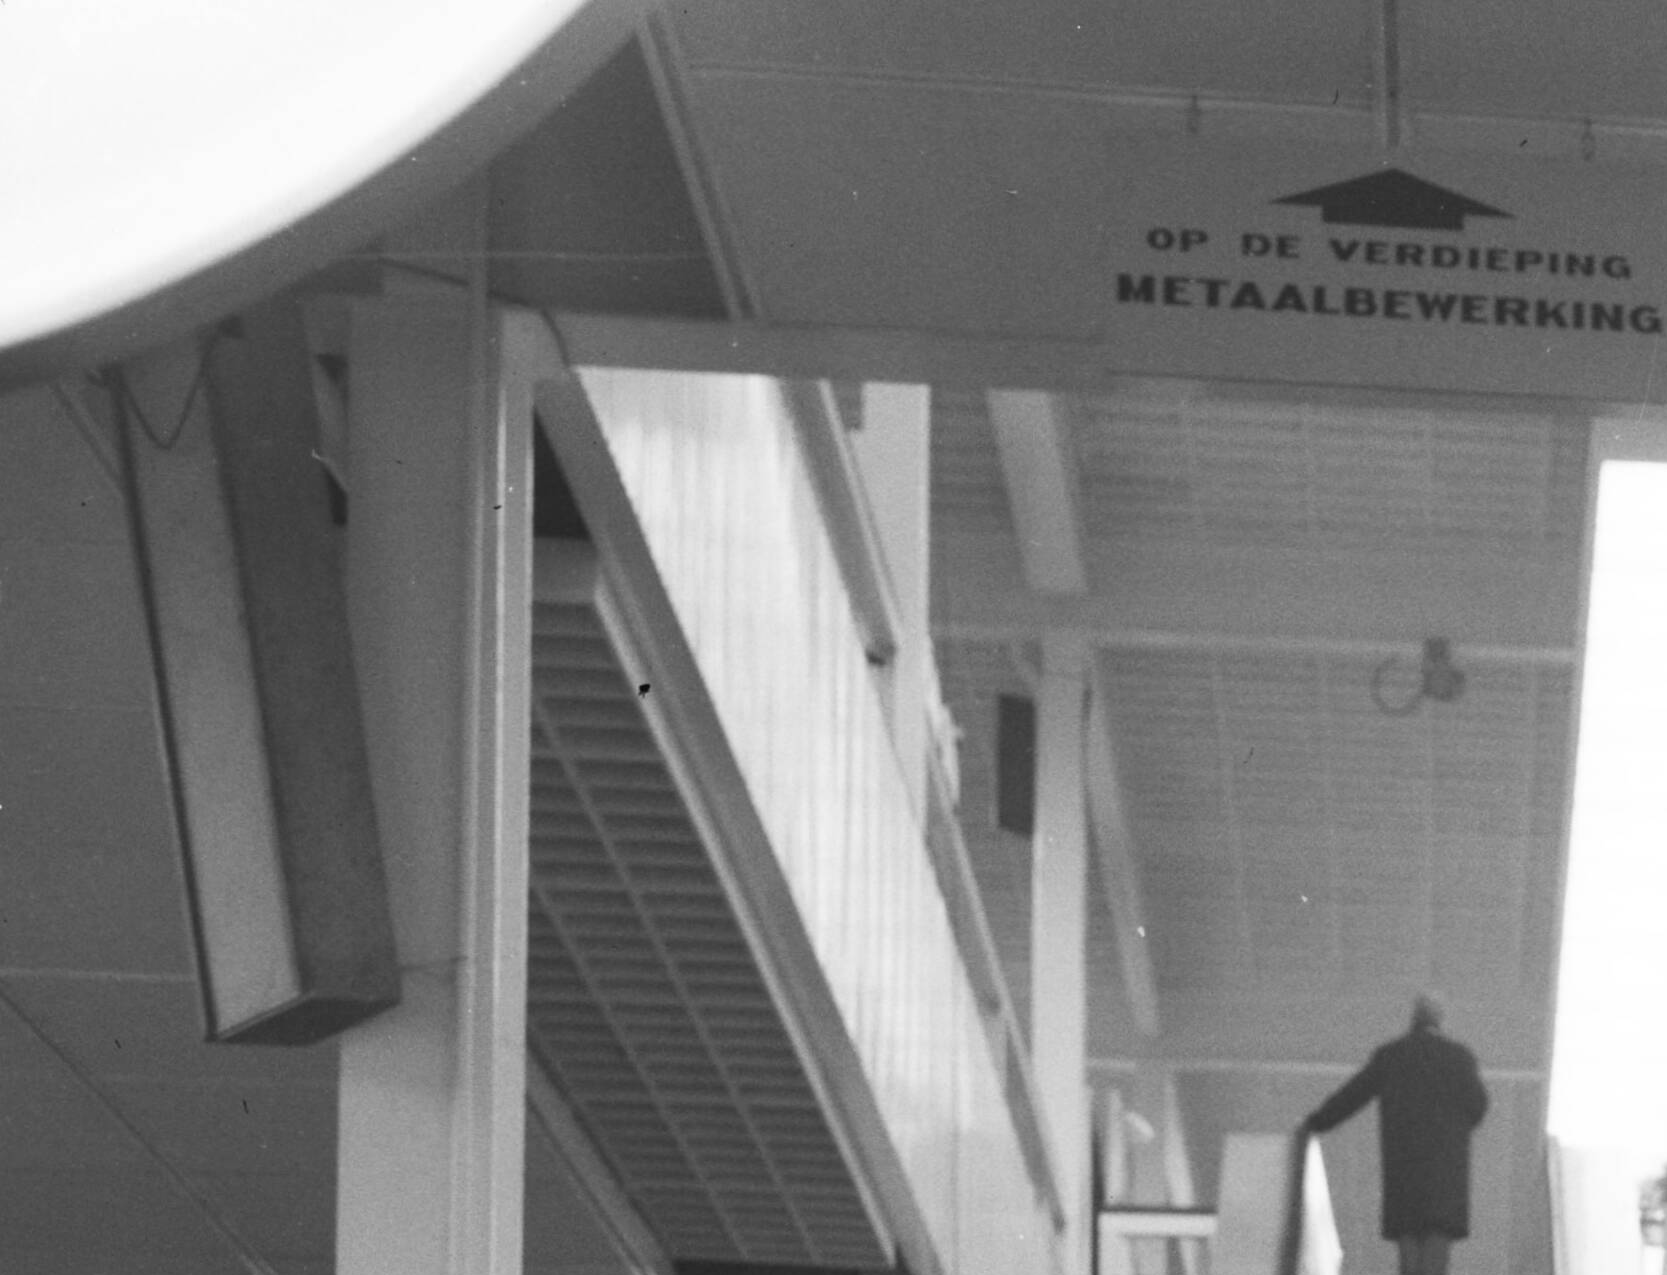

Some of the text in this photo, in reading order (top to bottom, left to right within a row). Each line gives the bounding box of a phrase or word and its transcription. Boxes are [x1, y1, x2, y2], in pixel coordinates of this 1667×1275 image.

[1146, 227, 1633, 281] OP DE VERDIEPING
[1116, 273, 1664, 335] METAALBEWERKING
